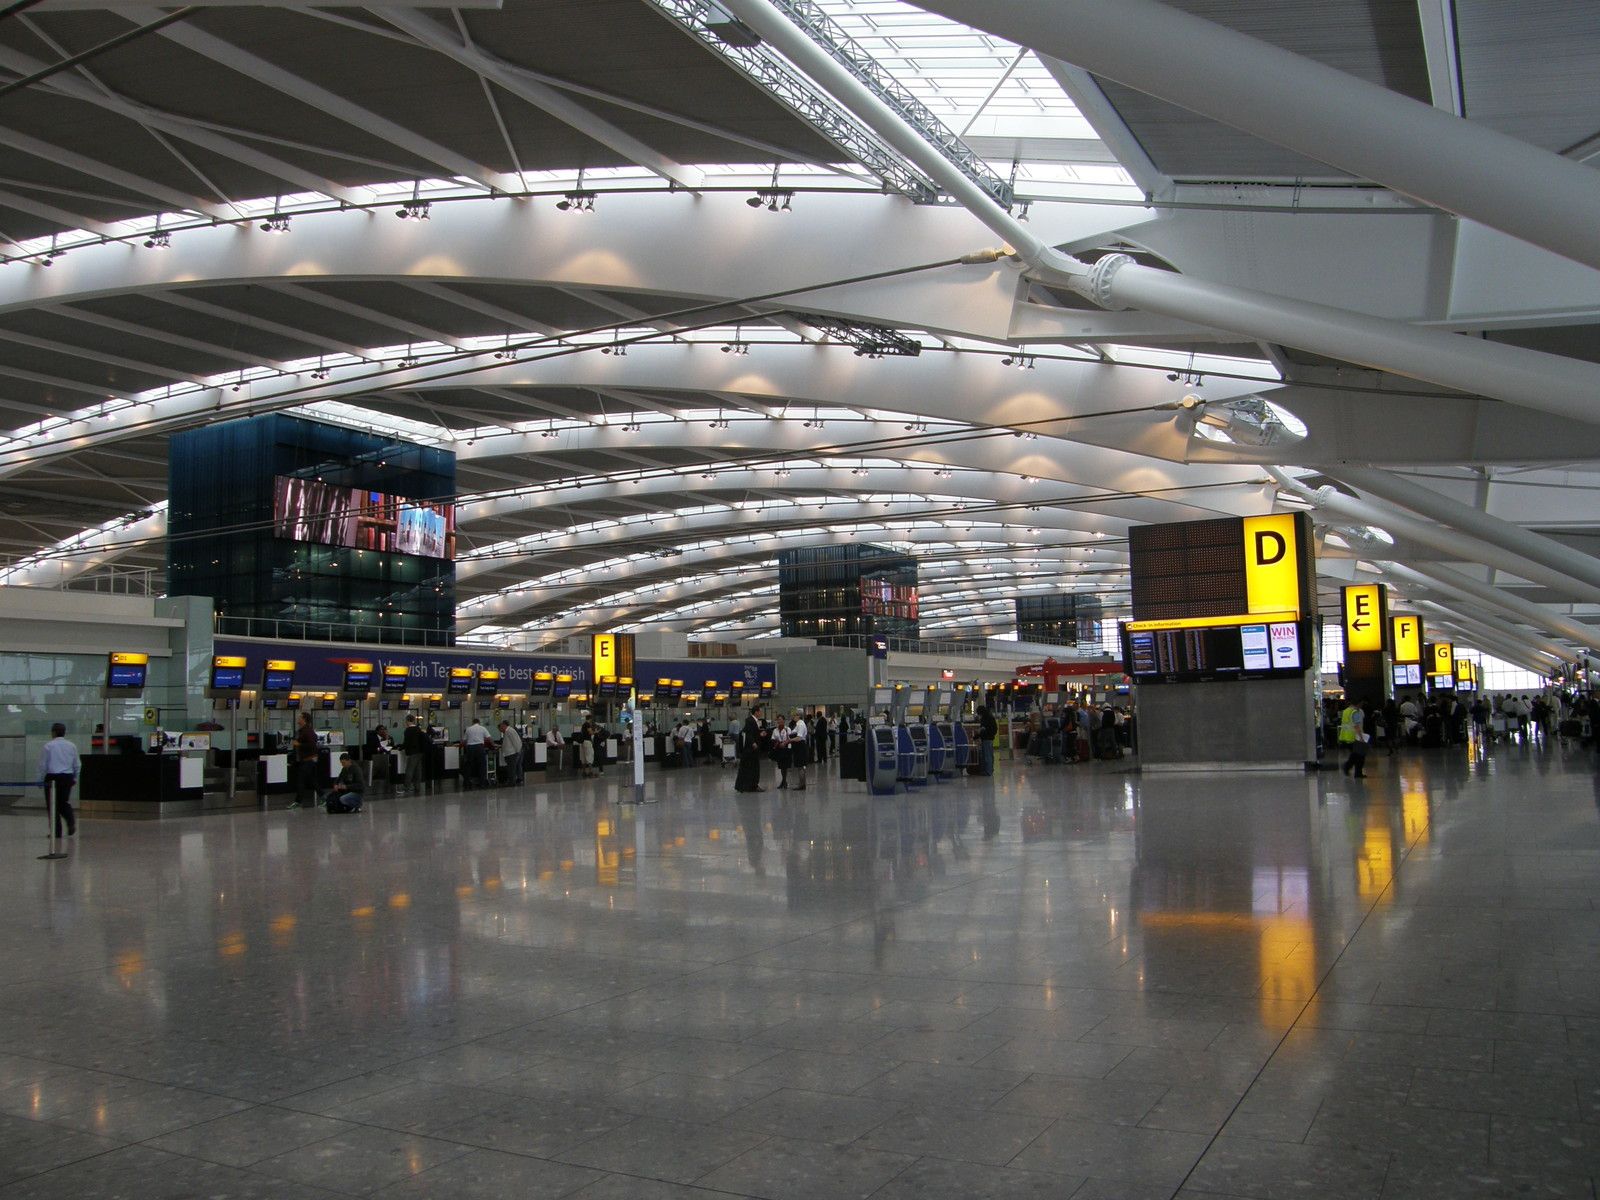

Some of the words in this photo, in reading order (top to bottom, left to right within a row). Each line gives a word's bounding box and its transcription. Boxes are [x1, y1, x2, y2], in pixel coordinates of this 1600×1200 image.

[1255, 530, 1286, 566] D
[1355, 594, 1370, 616] E
[1271, 627, 1295, 637] WIN
[1400, 622, 1411, 639] F
[600, 640, 609, 657] E
[1437, 647, 1448, 658] G
[431, 661, 450, 679] Tea
[509, 664, 533, 680] best
[1460, 661, 1468, 669] H
